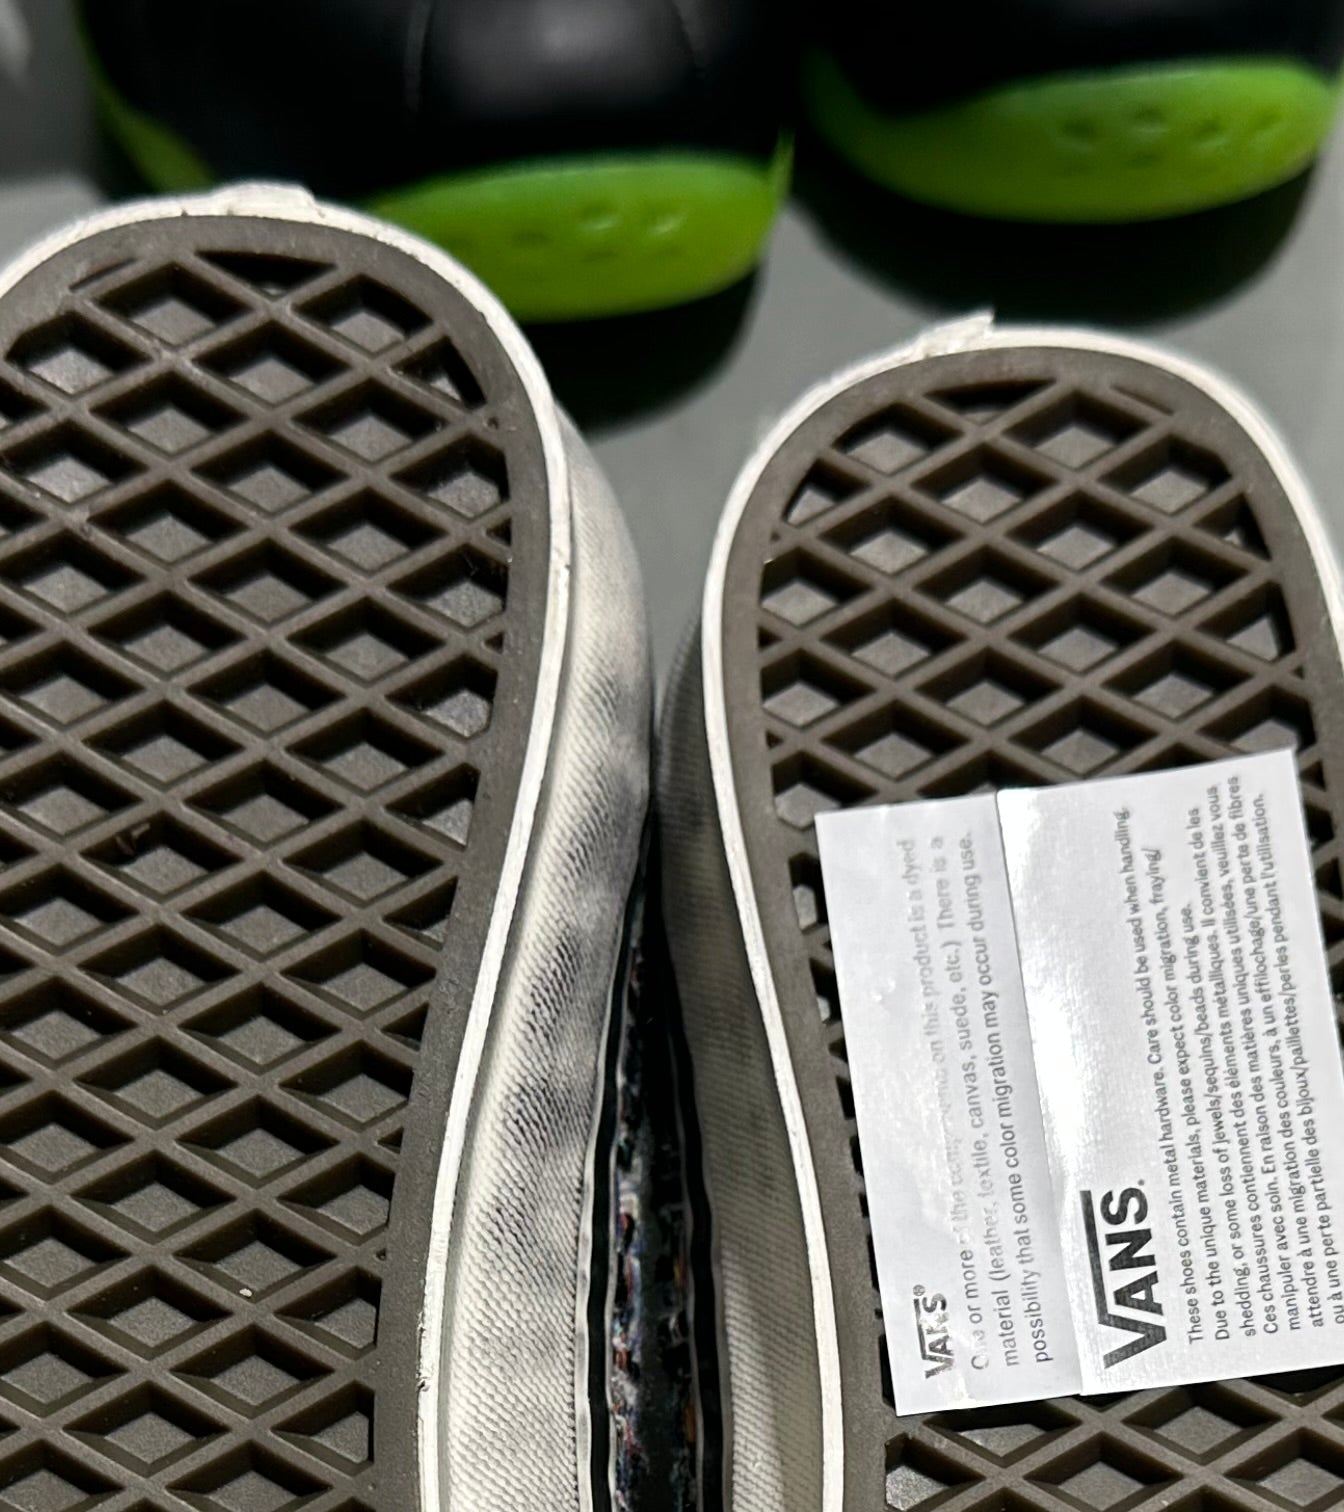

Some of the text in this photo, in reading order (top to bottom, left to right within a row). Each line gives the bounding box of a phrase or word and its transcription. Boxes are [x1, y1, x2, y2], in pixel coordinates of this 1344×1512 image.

[1185, 806, 1201, 830] les
[1205, 784, 1222, 822] vous
[1226, 775, 1244, 820] fibres
[929, 834, 945, 850] a
[1187, 830, 1205, 850] de
[1209, 822, 1231, 878] veuillez
[1230, 821, 1248, 841] de
[895, 837, 923, 886] dyed
[930, 854, 948, 873] is
[1192, 850, 1215, 916] convient
[1235, 842, 1257, 885] perte
[934, 876, 957, 931] There
[1179, 902, 1195, 933] use.
[1198, 916, 1217, 928] Il
[1262, 879, 1289, 943] pendant
[907, 922, 942, 998] product
[940, 938, 964, 984] etc.)
[1153, 905, 1178, 982] migration,
[1181, 933, 1203, 984] during
[1229, 945, 1251, 1006] uniques
[948, 985, 974, 1052] suede,
[1162, 984, 1183, 1023] color
[1261, 1003, 1277, 1025] un
[1168, 1023, 1191, 1076] expect
[1261, 1025, 1279, 1037] à
[959, 1052, 985, 1130] canvas,
[1112, 806, 1204, 1345] These shoes contain metal hardware. Care should be used when handling.
[1247, 1074, 1266, 1103] des
[1267, 1038, 1289, 1109] couleurs,
[957, 829, 1055, 1364] possibility that some color migration may occur during use.
[1178, 1077, 1201, 1127] please
[1227, 1089, 1246, 1119] des
[1254, 1103, 1273, 1152] raison
[1275, 1109, 1295, 1139] des
[1299, 1117, 1318, 1146] des
[1183, 1127, 1210, 1204] materials,
[1210, 1146, 1230, 1164] of
[1231, 1119, 1261, 1212] contiennent
[1259, 1153, 1277, 1175] En
[1281, 1139, 1307, 1214] migration
[1217, 1164, 1235, 1197] loss
[1263, 1175, 1283, 1213] soin.
[1303, 1147, 1333, 1212] partielle
[1198, 1205, 1219, 1258] unique
[1223, 1198, 1243, 1240] some
[1271, 1214, 1289, 1251] avec
[1294, 1215, 1312, 1245] une
[1315, 1213, 1340, 1257] perte
[1230, 1242, 1246, 1261] or
[1248, 1213, 1275, 1302] chaussures
[1295, 1246, 1313, 1258] à
[958, 1247, 981, 1300] more
[1203, 1259, 1223, 1288] the
[1274, 1253, 1302, 1331] manipuler
[1298, 1259, 1325, 1328] attendre
[1324, 1258, 1342, 1289] une
[1325, 1289, 1344, 1301] à
[965, 1302, 984, 1325] or
[1209, 1288, 1226, 1307] to
[1231, 1261, 1257, 1337] shedding,
[1261, 1303, 1279, 1335] Ces
[988, 1288, 1021, 1368] material
[1213, 1308, 1231, 1341] Due
[965, 1327, 991, 1371] Oe
